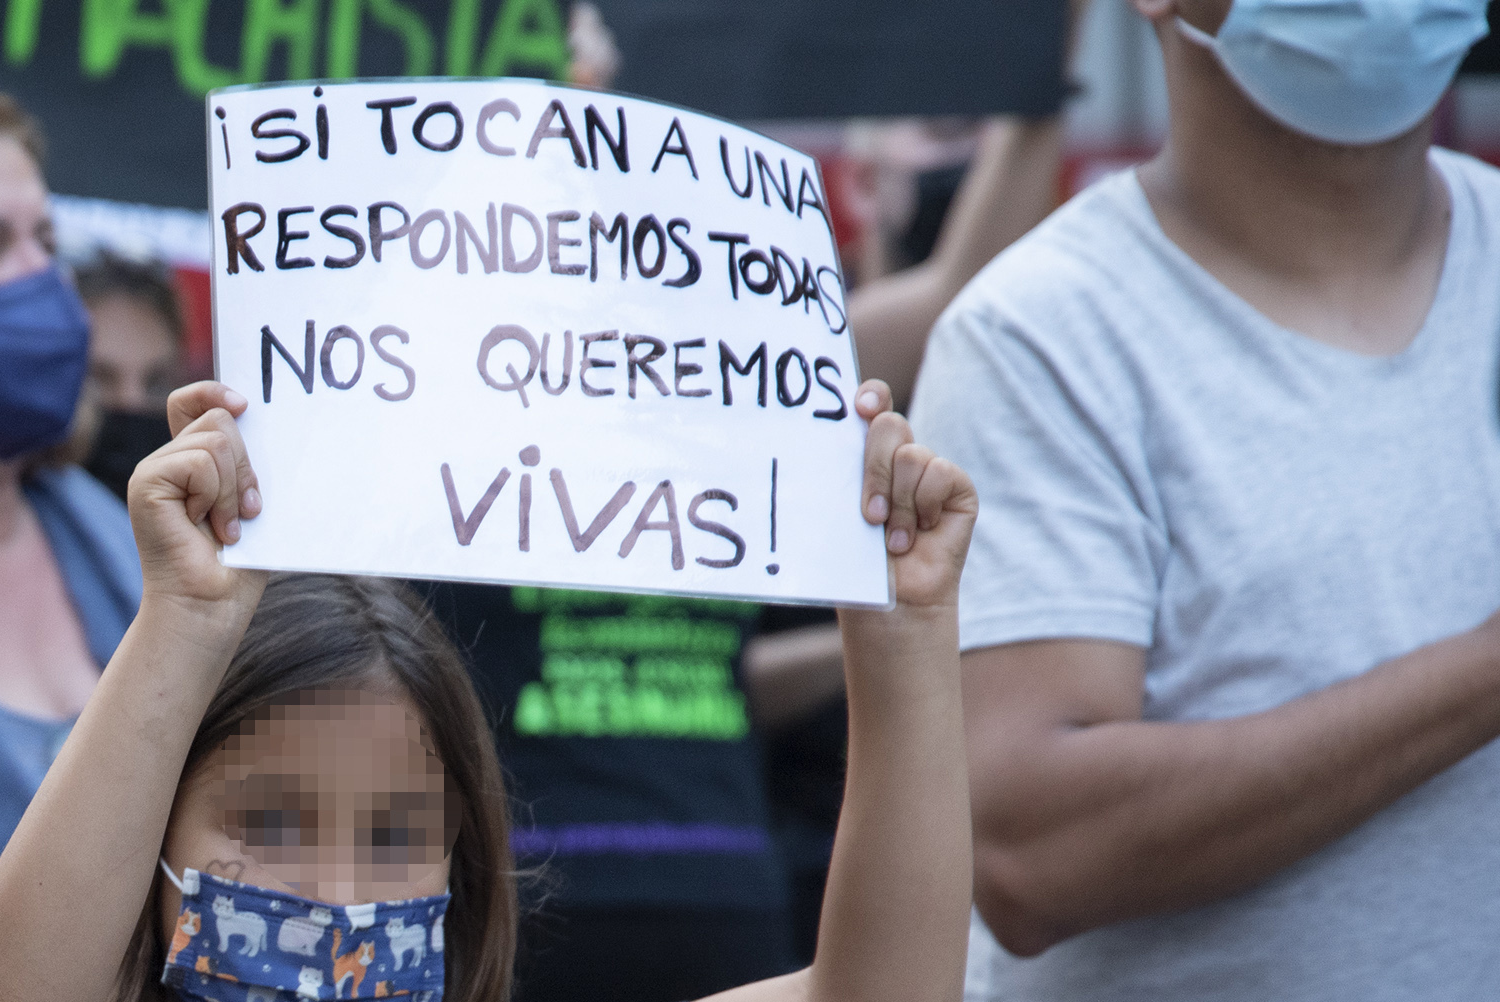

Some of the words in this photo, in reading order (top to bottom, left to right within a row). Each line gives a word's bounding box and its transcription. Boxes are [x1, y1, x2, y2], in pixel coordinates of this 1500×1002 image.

[365, 96, 632, 176] TOCAN
[650, 116, 700, 182] A
[718, 134, 834, 238] UNA
[220, 201, 703, 291] RESPONDEMOS
[706, 231, 848, 336] TODAS
[260, 319, 418, 404] NOS
[476, 323, 849, 424] QUEREMOS
